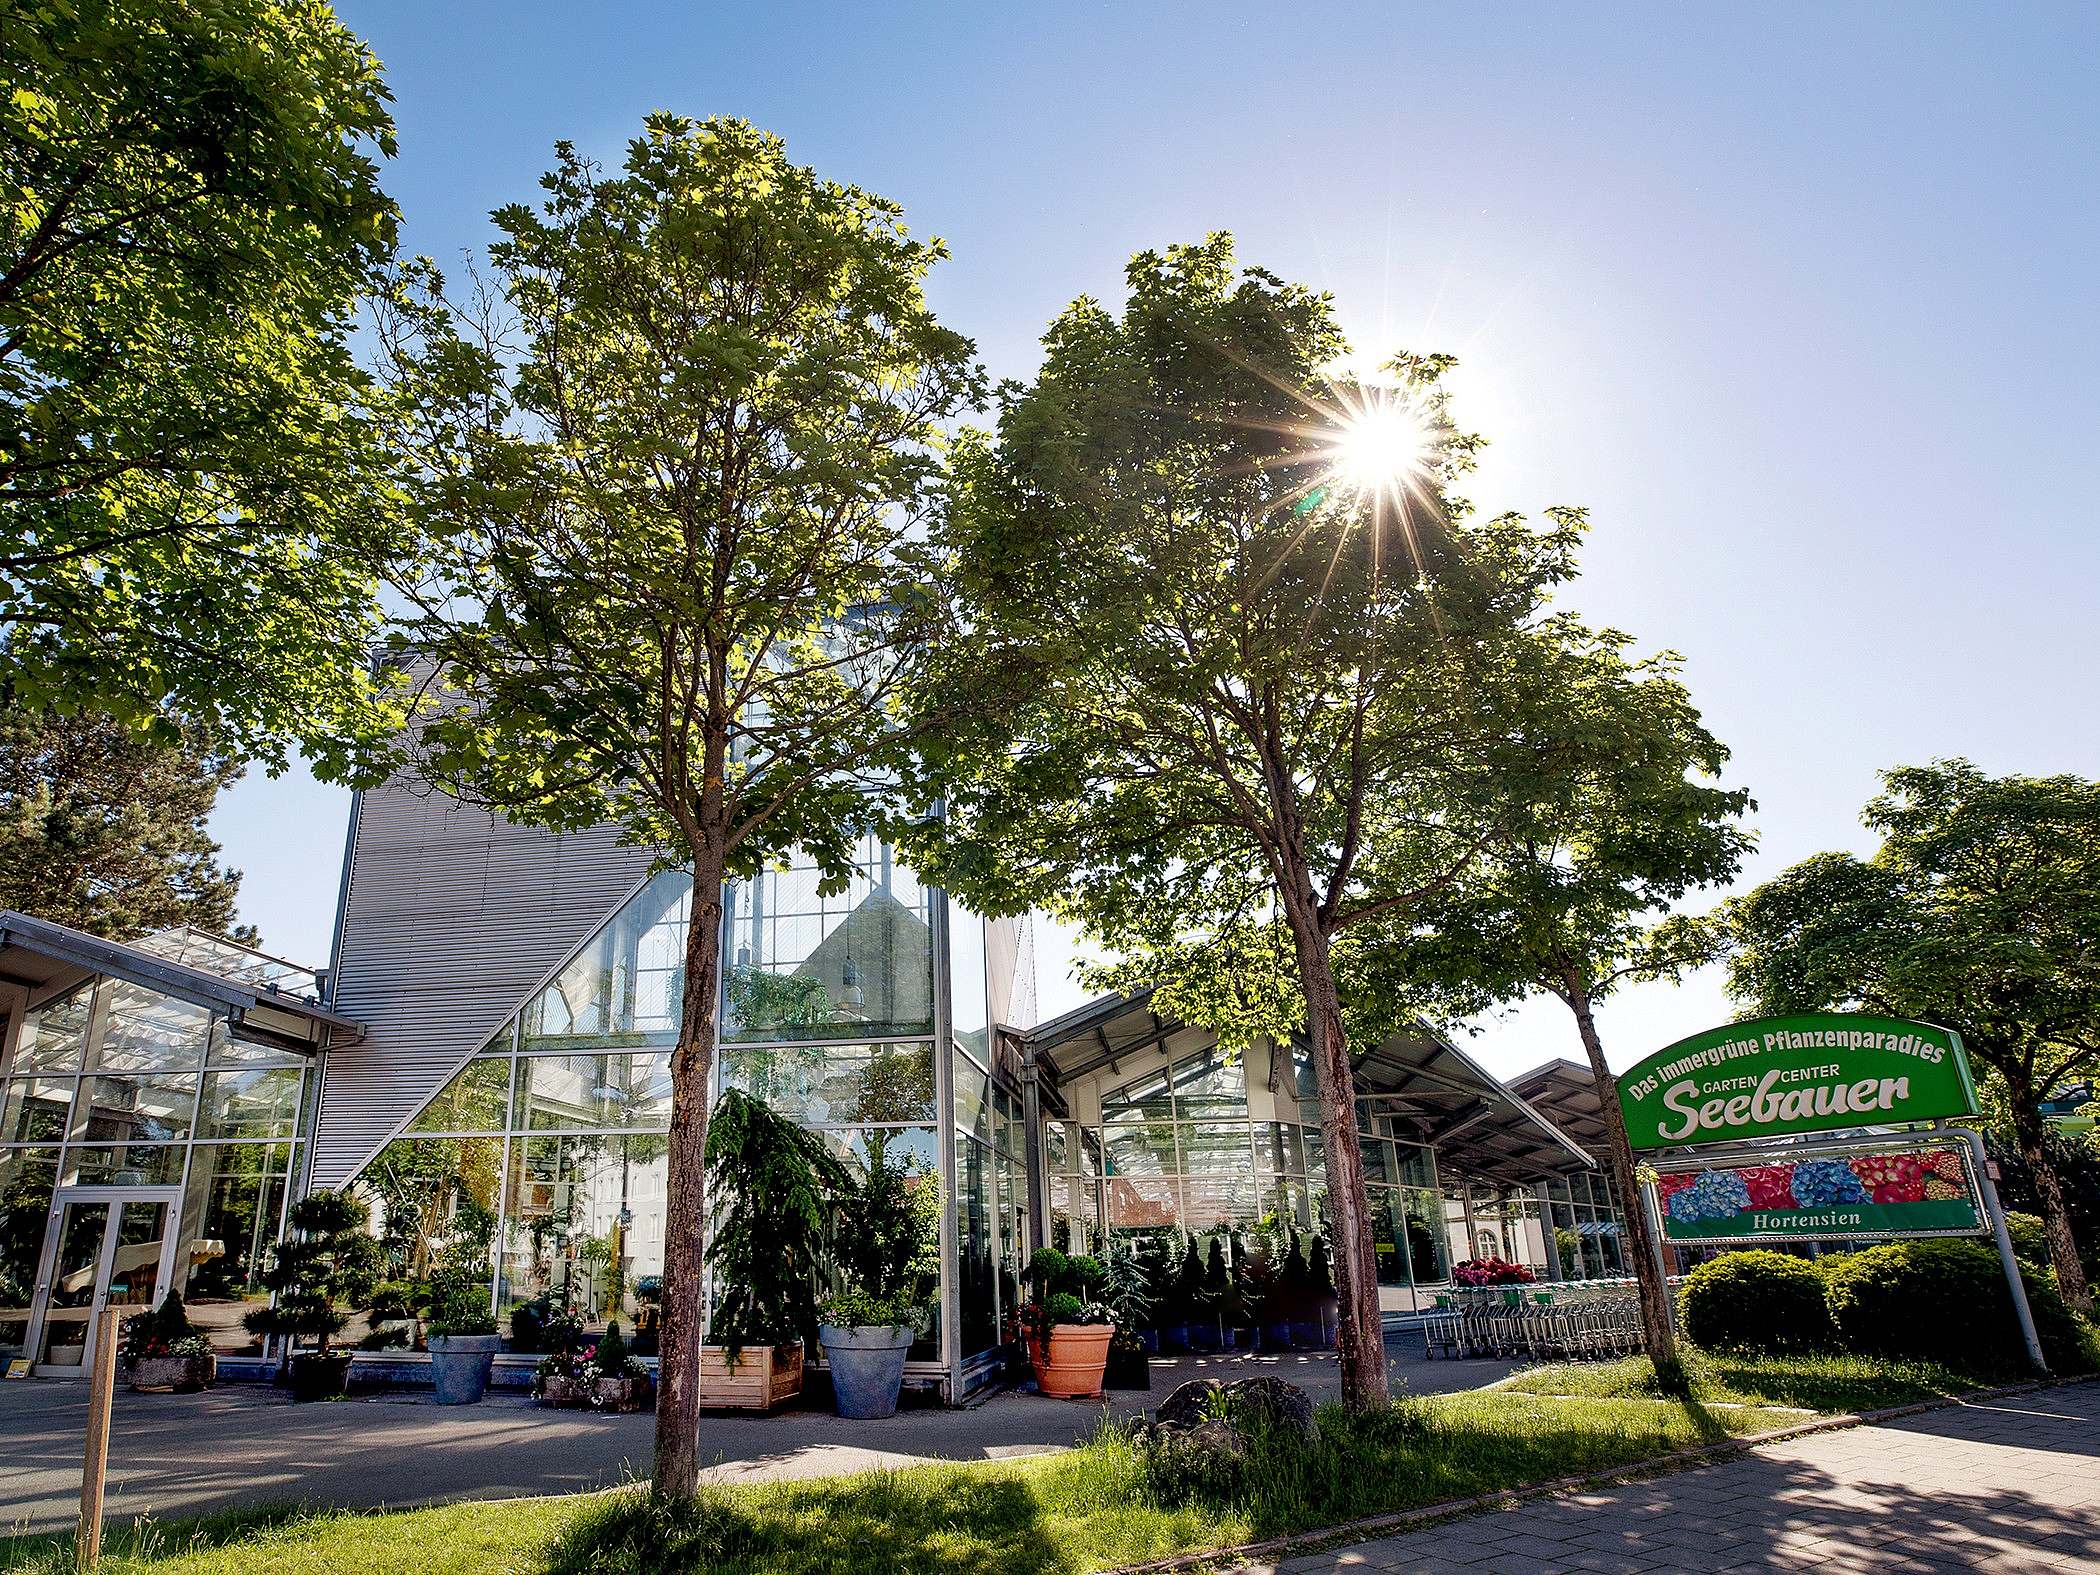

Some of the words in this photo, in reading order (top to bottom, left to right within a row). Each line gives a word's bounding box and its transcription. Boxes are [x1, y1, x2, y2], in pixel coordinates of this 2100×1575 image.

[1628, 1075, 1659, 1101] Das
[1656, 1038, 1760, 1083] immergrüne
[1763, 1030, 1946, 1064] Pflanzenparadies
[1703, 1075, 1758, 1094] GARTEN
[1780, 1064, 1840, 1083] CENTER
[1658, 1069, 1909, 1140] Seebauer
[1753, 1211, 1862, 1229] Hortensien
